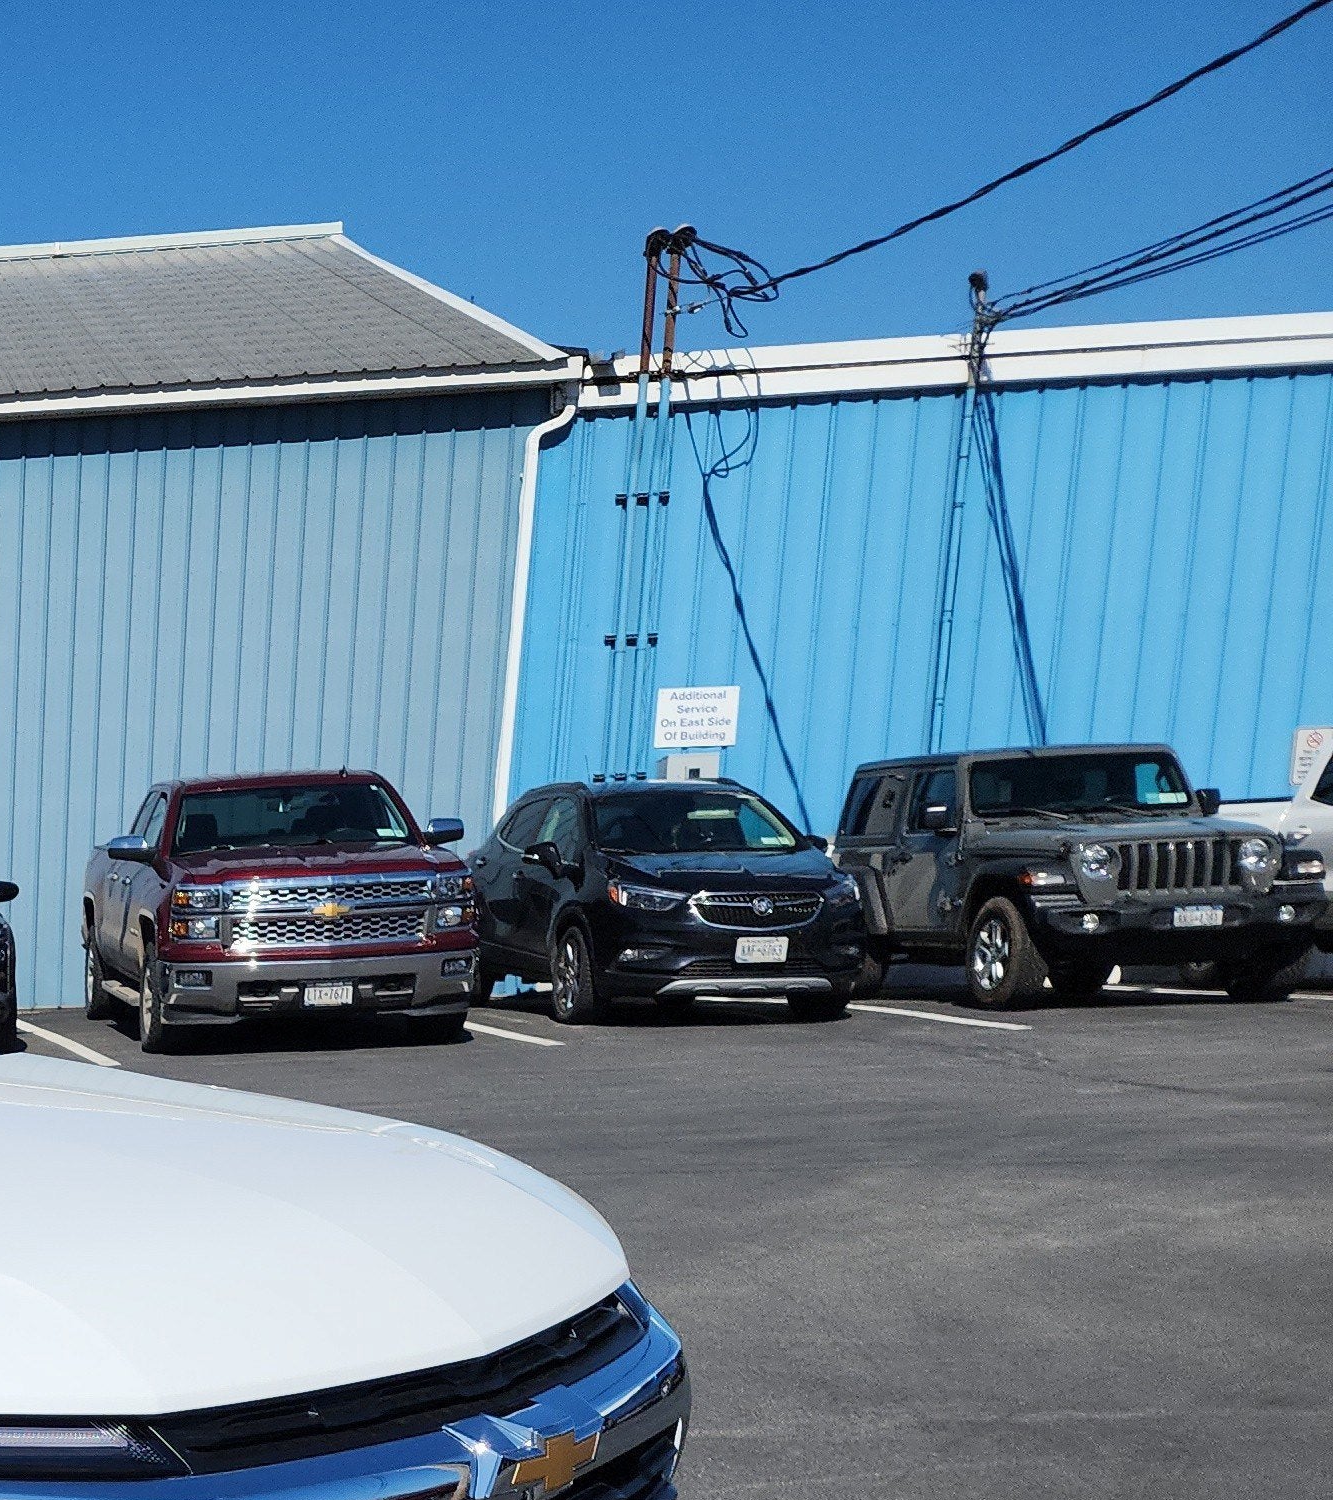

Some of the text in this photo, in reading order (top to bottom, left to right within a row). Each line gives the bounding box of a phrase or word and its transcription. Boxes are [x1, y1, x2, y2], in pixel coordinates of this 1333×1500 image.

[670, 691, 727, 700] Additional
[677, 705, 718, 714] Service
[661, 717, 731, 727] On East Side
[664, 731, 726, 742] Of Building
